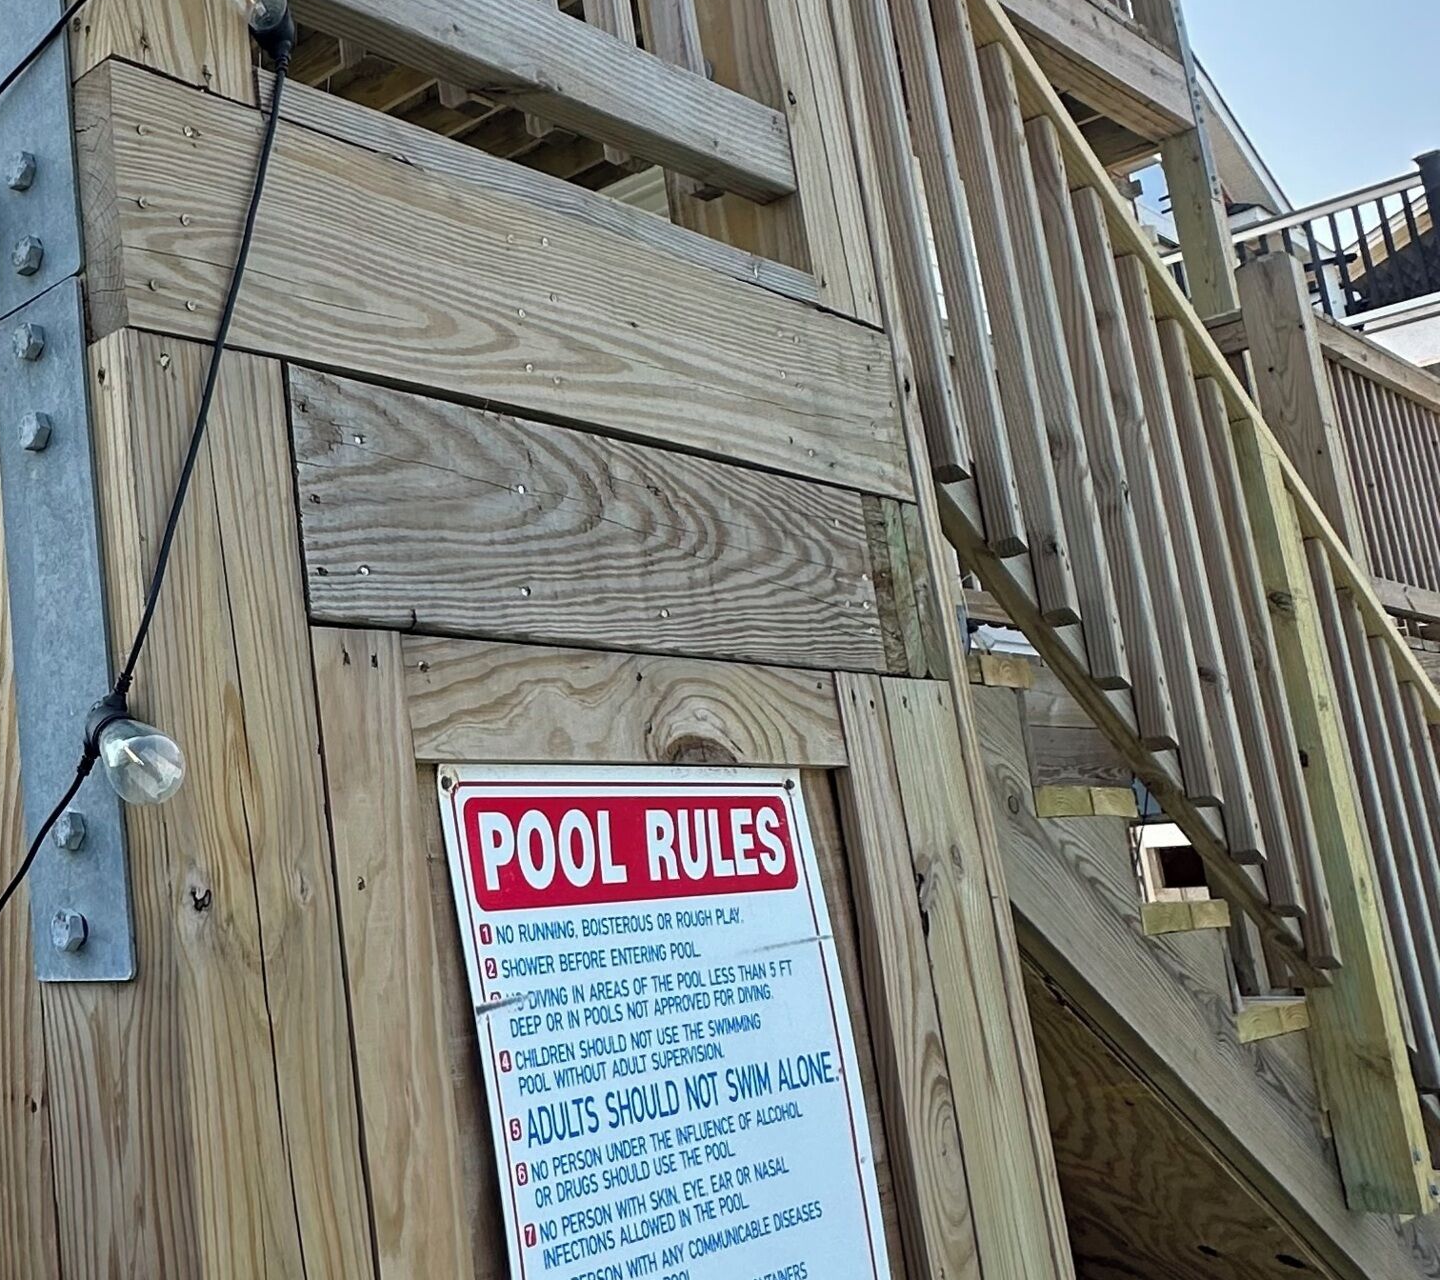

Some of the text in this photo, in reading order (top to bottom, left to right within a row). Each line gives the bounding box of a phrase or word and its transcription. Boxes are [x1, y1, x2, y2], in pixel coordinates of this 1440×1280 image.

[476, 806, 786, 892] POOL RULES
[481, 925, 490, 943] 1
[495, 924, 514, 944] NO
[581, 913, 653, 937] BOISTEROUS
[656, 912, 672, 930] OR
[675, 909, 712, 928] ROUGH
[486, 943, 666, 978] 2 SHOWER BEFORE ENTERING
[527, 986, 568, 1009] DIVING
[571, 983, 585, 1004] IN
[589, 978, 629, 1001] AREAS
[632, 976, 647, 995] OF
[650, 973, 674, 993] THE
[676, 970, 706, 989] POOL
[707, 965, 735, 986] LESS
[737, 962, 766, 981] THAN
[768, 961, 776, 977] 5
[778, 959, 792, 976] FT
[500, 1012, 761, 1070] 4 CHILDREN SHOULD NOT USE THE SWIMMING
[509, 1014, 541, 1038] DEEP
[545, 1011, 564, 1032] OR
[566, 1008, 580, 1029] IN
[583, 1003, 623, 1026] POOLS
[625, 999, 648, 1020] NOT
[653, 991, 710, 1016] APPROVED
[712, 987, 735, 1006] FOR
[517, 1072, 551, 1096] POOL
[552, 1061, 606, 1089] WITHOUT
[612, 1053, 646, 1078] ADULT
[511, 1120, 520, 1139] 5
[527, 1095, 599, 1148] ADULTS
[604, 1080, 679, 1128] SHOULD
[683, 1071, 718, 1111] NOT
[725, 1061, 772, 1102] SWIM
[517, 1101, 803, 1184] 6 NO PERSON UNDER THE INFLUENCE OF ALCOHOL
[534, 1146, 703, 1208] OR DRUGS SHOULD USE THE
[625, 1251, 657, 1278] WITH
[662, 1242, 684, 1268] ANY
[687, 1215, 771, 1259] COMMUNICABLE
[772, 1199, 822, 1231] DISEASES
